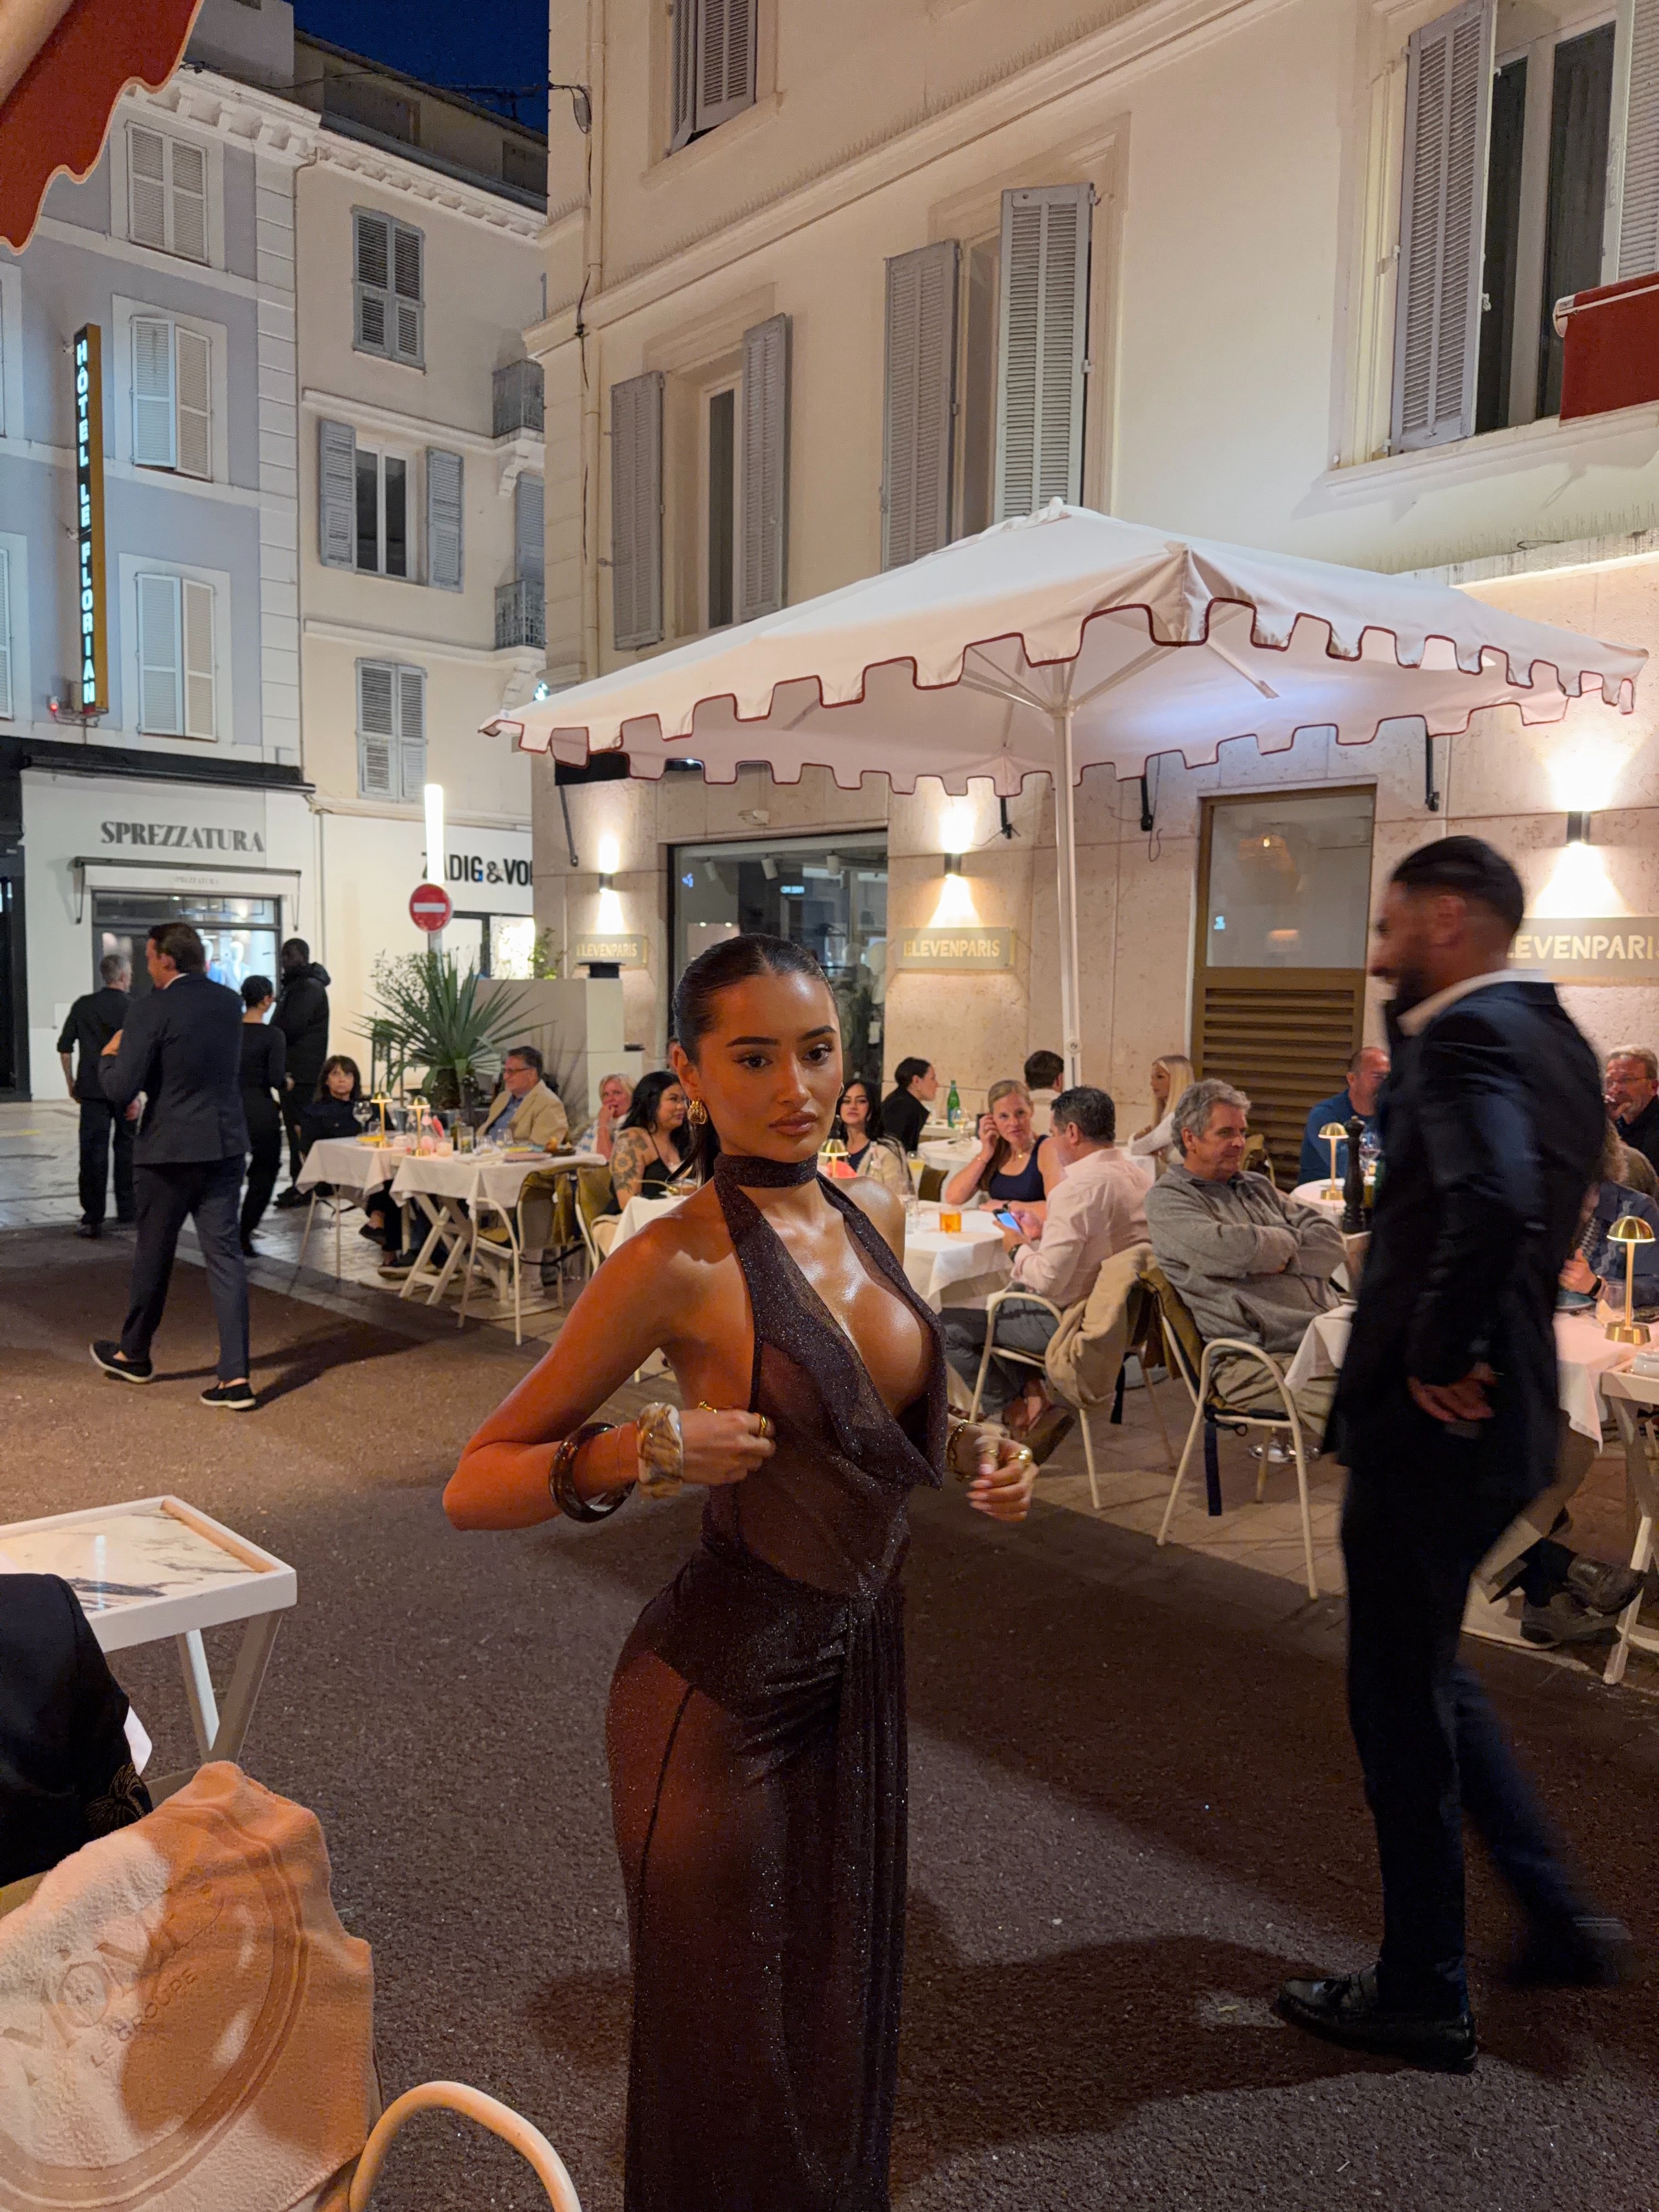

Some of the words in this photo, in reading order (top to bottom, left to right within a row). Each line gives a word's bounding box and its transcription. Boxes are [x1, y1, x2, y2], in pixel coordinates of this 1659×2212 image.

[77, 339, 89, 467] HÔTEL
[81, 483, 91, 527] LE
[81, 541, 96, 704] FLORIAN
[100, 821, 264, 853] SPREZZATURA
[421, 852, 533, 886] DIG&VO
[903, 939, 1001, 957] ELEVENPARIS
[1506, 935, 1659, 960] EVENPARI
